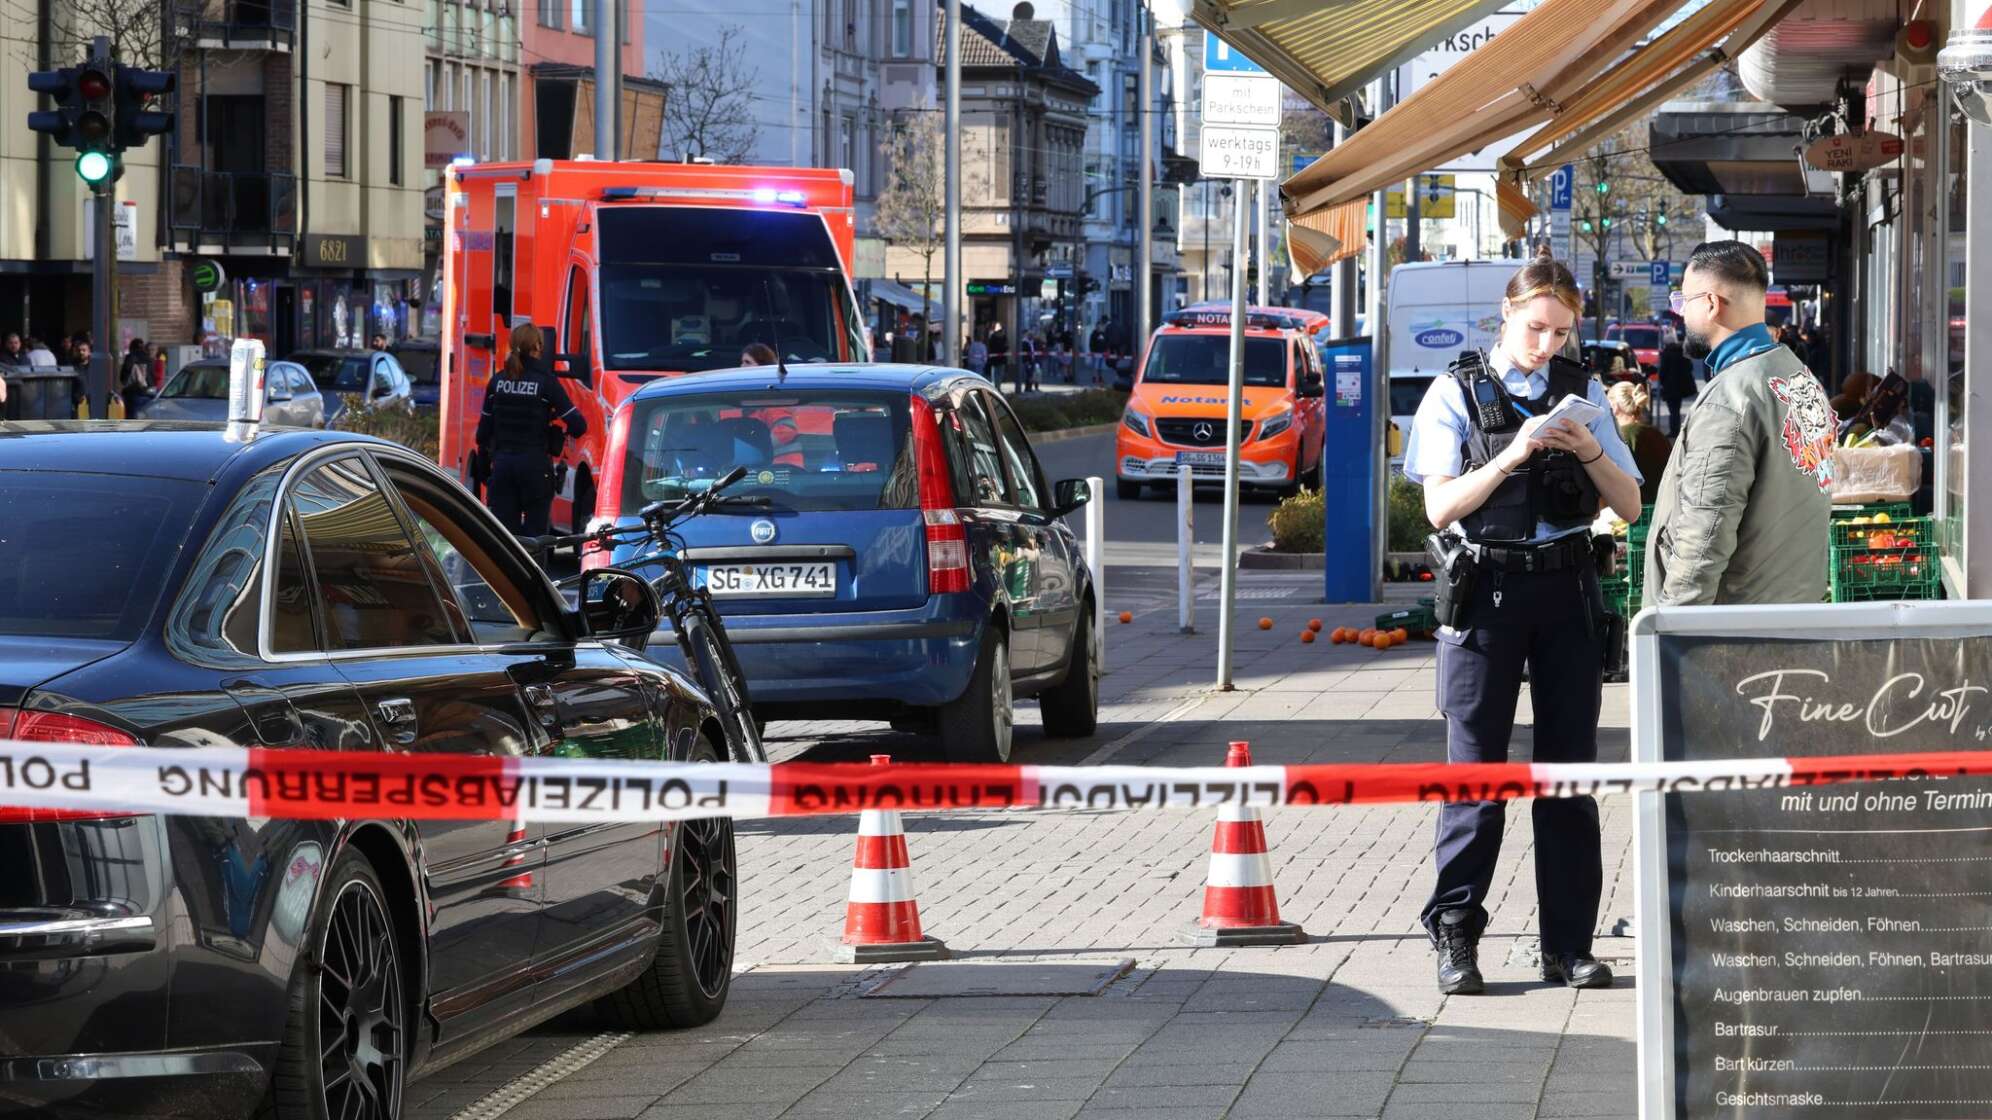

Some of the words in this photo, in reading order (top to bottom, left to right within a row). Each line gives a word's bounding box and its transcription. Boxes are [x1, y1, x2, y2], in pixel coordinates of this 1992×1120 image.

[1232, 87, 1251, 97] mit
[1209, 101, 1274, 115] Parkschein
[1208, 136, 1272, 154] werktags
[1554, 169, 1567, 205] P
[319, 240, 347, 261] 6821
[1653, 264, 1664, 282] P
[1197, 314, 1254, 325] NOTAT
[496, 379, 538, 396] POLIZEI
[712, 568, 740, 589] SG
[1736, 669, 1864, 741] Fine
[1866, 672, 1988, 738] Cut
[158, 766, 727, 810] POLIZEIABSPERRUNG
[1781, 791, 1813, 811] mit
[1819, 791, 1859, 811] und
[1864, 790, 1917, 811] ohne
[1709, 883, 1830, 897] Kinderhaarschnit
[1833, 887, 1848, 897] bis
[1850, 886, 1863, 897] 12
[1710, 918, 1780, 934] Waschen,
[1784, 917, 1864, 933] Schneiden,
[1867, 917, 1921, 932] Föhnen
[1712, 953, 1781, 969] Waschen,
[1785, 952, 1865, 968] Schneiden,
[1869, 952, 1926, 968] Föhnen,
[1714, 988, 1809, 1005] Augenbrauen
[1813, 987, 1862, 1004] zupfen
[1715, 1022, 1778, 1036] Bartrasur
[1715, 1057, 1745, 1071] Bart
[1715, 1091, 1824, 1106] Gesichtsmaske
